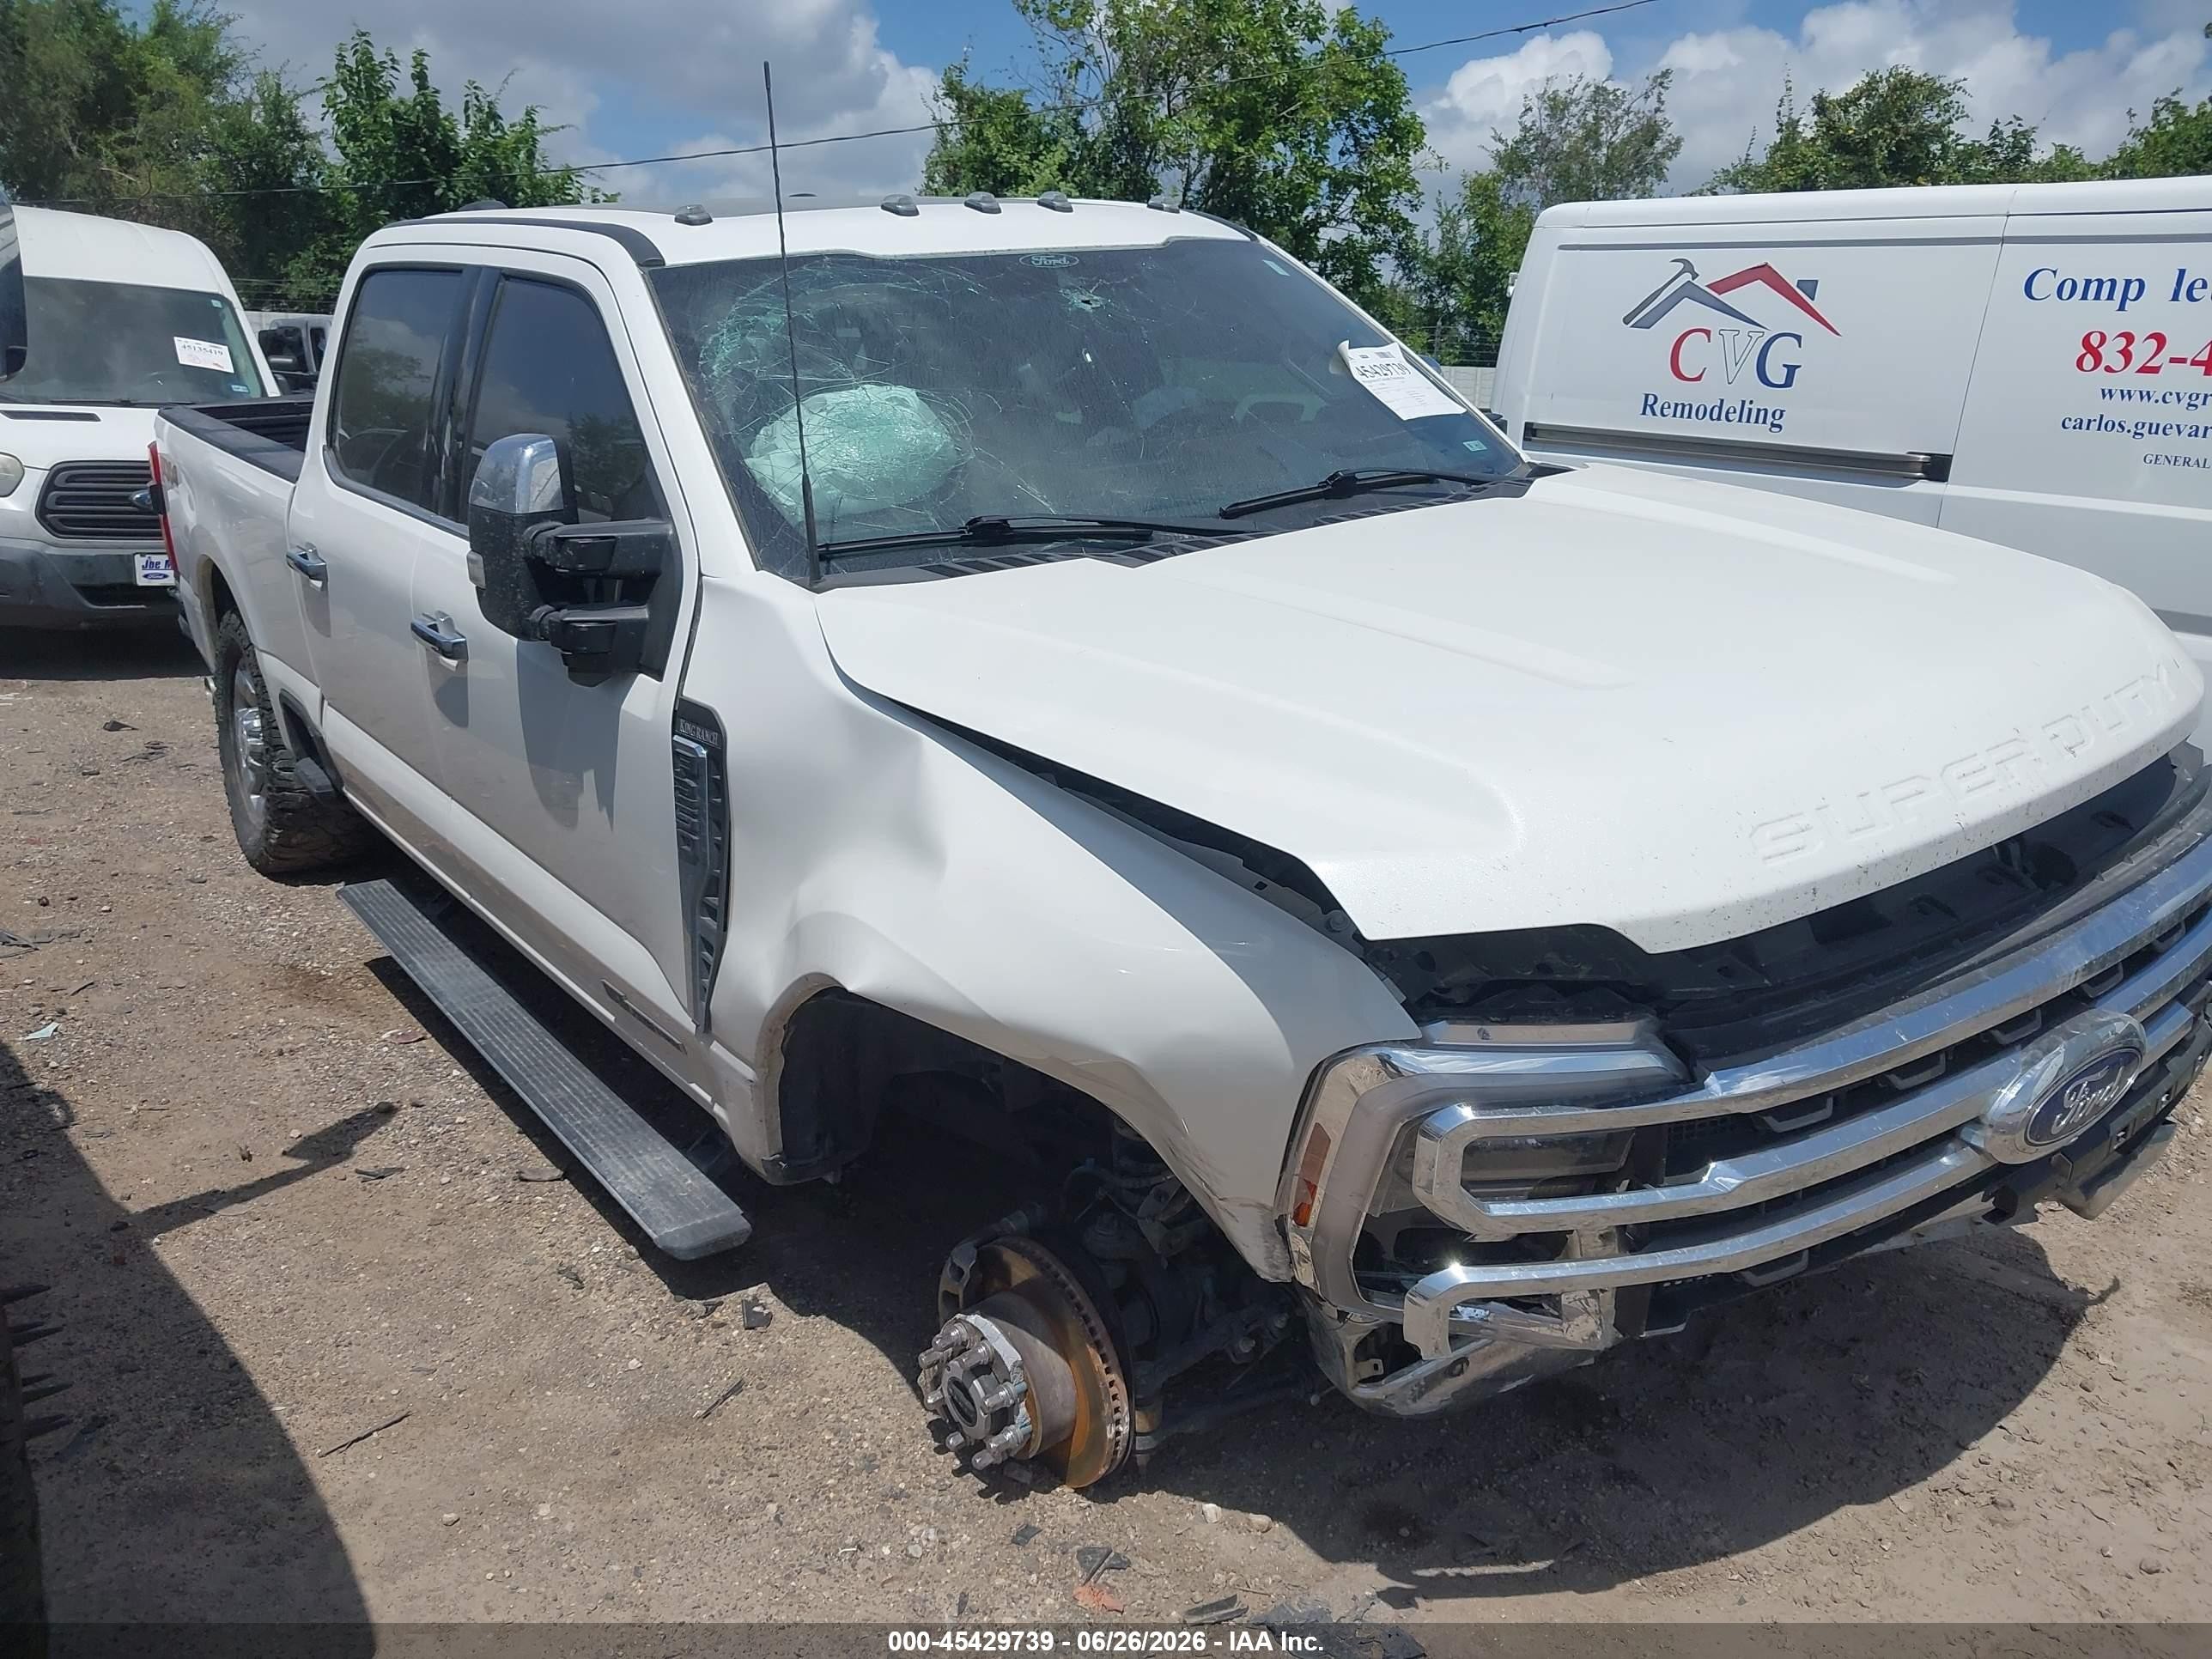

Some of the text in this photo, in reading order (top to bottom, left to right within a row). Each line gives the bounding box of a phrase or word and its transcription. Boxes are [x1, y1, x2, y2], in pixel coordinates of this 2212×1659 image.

[2024, 267, 2212, 312] Comp le
[1355, 362, 1412, 379] 45429739
[1670, 328, 1802, 389] CVG
[1641, 392, 1786, 434] Remodeling
[2143, 453, 2211, 469] GENERAL
[1750, 663, 2179, 866] SUPER DUTY
[2051, 1065, 2124, 1135] Ford
